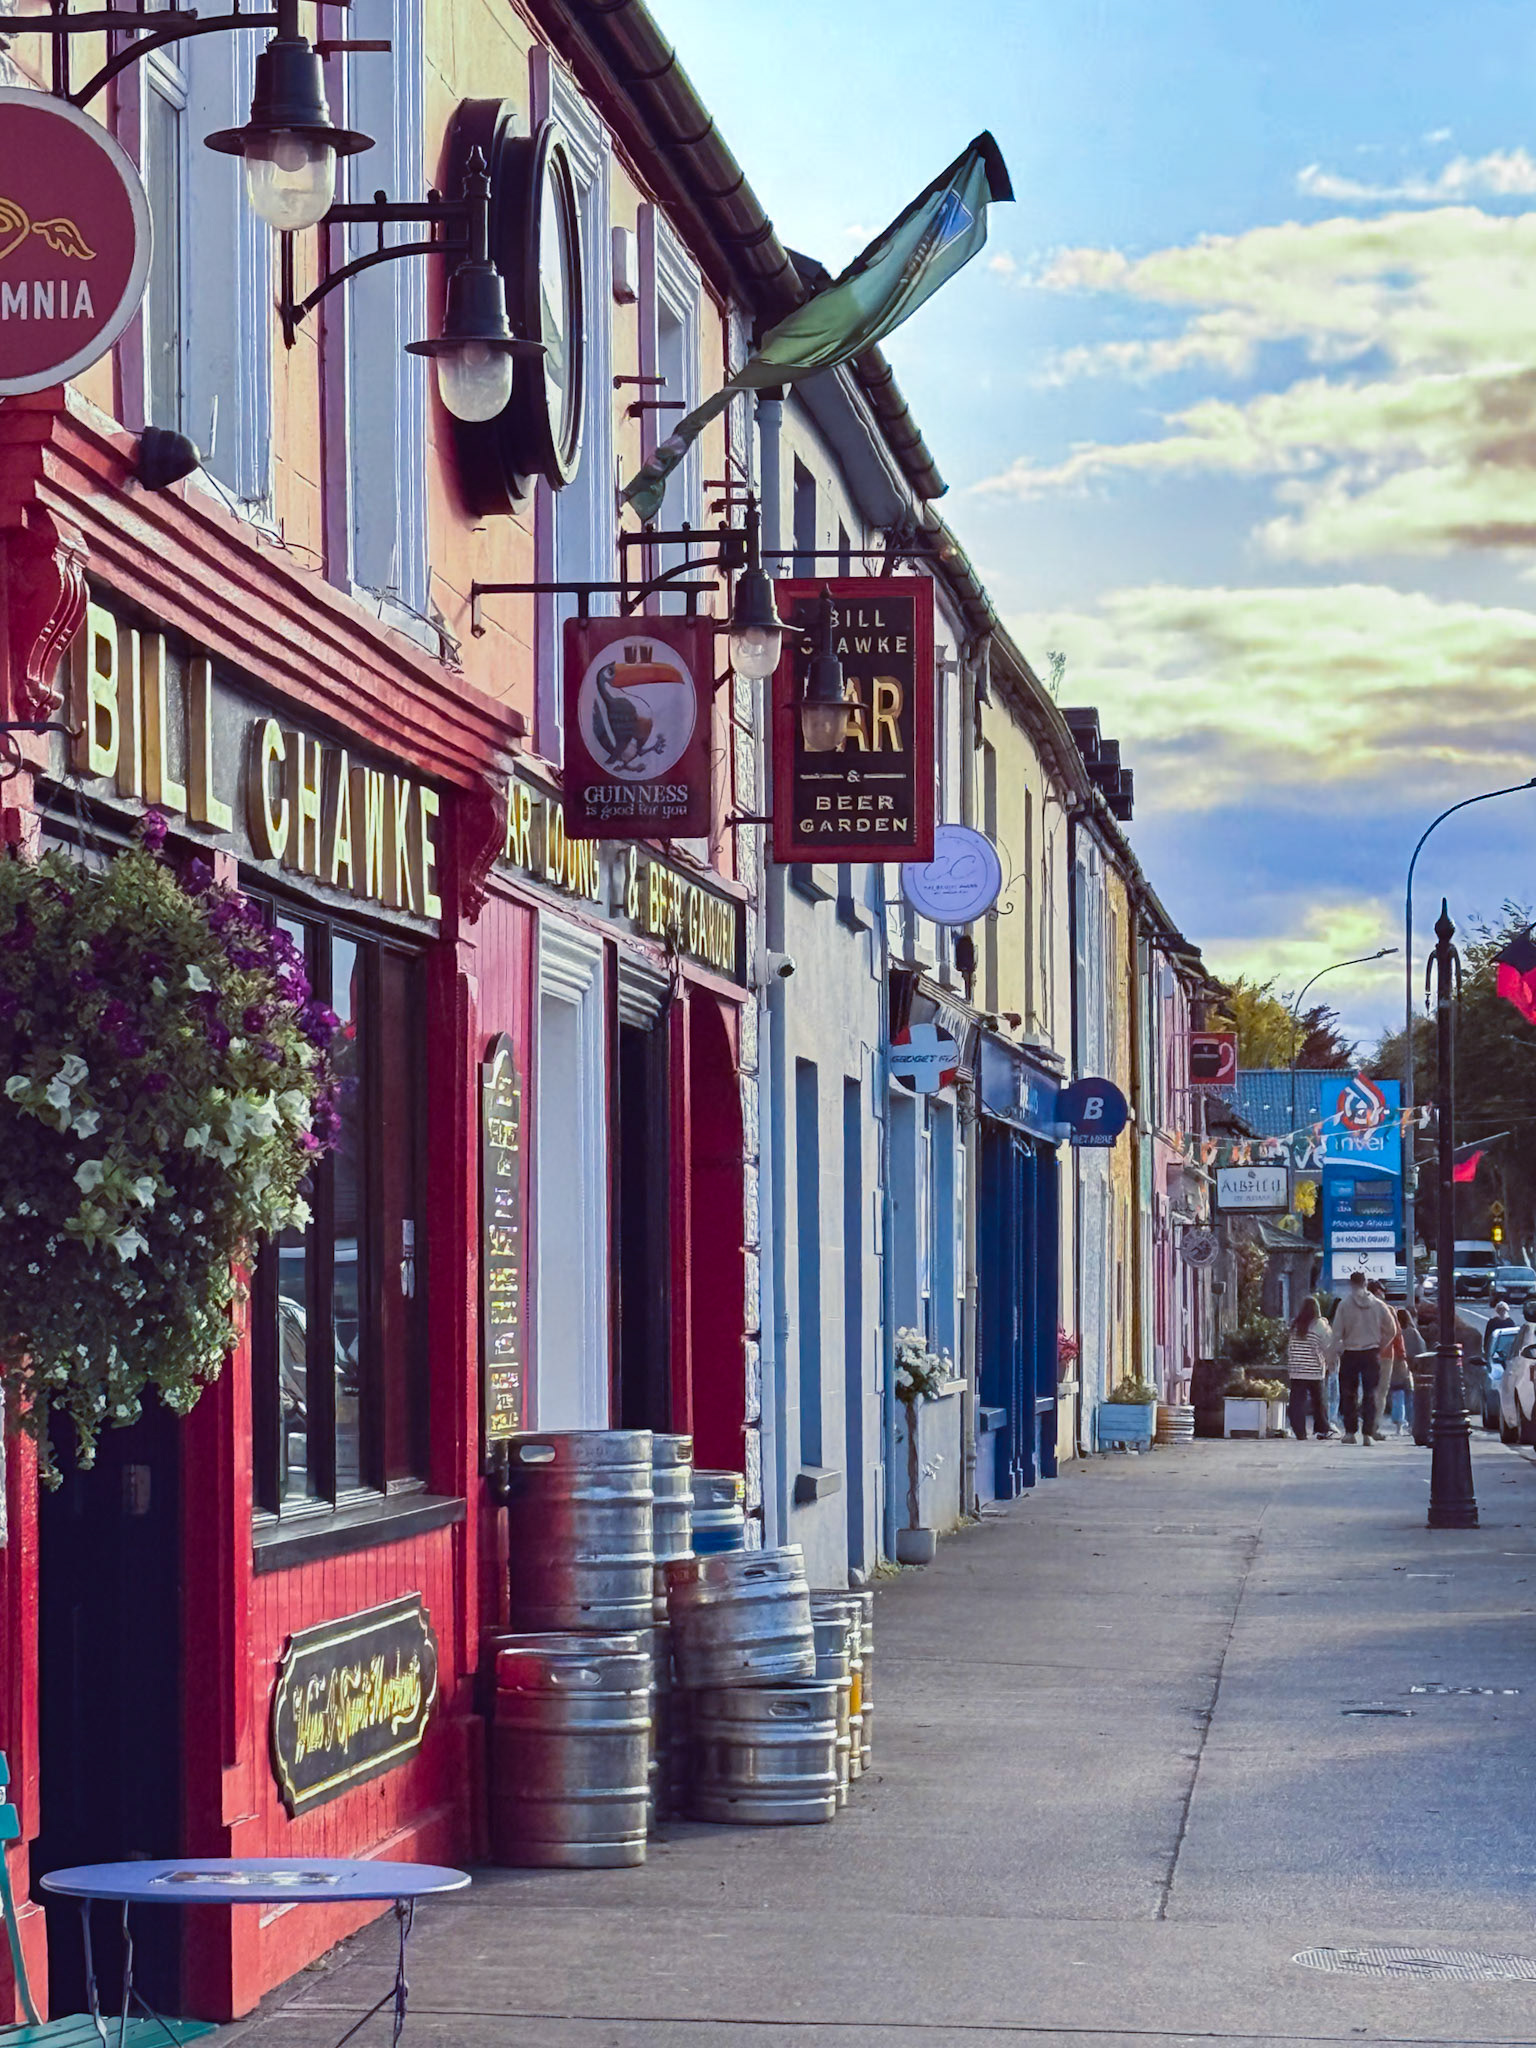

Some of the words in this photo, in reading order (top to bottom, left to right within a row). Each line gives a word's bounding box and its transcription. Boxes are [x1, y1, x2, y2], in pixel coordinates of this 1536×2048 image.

[1, 280, 95, 321] MNIA
[800, 636, 908, 655] CAWKE
[803, 675, 904, 753] AR
[84, 600, 233, 834] BILL
[258, 718, 442, 920] CHAWKE
[846, 769, 861, 783] &
[583, 784, 689, 804] GUINNESS
[815, 795, 895, 812] BEER
[585, 806, 598, 816] is
[600, 803, 635, 820] good
[661, 805, 688, 819] you
[799, 817, 908, 834] GARDEN
[499, 777, 533, 872] AR
[627, 844, 639, 920] &
[688, 884, 737, 974] GARDEN
[1083, 1097, 1105, 1120] B
